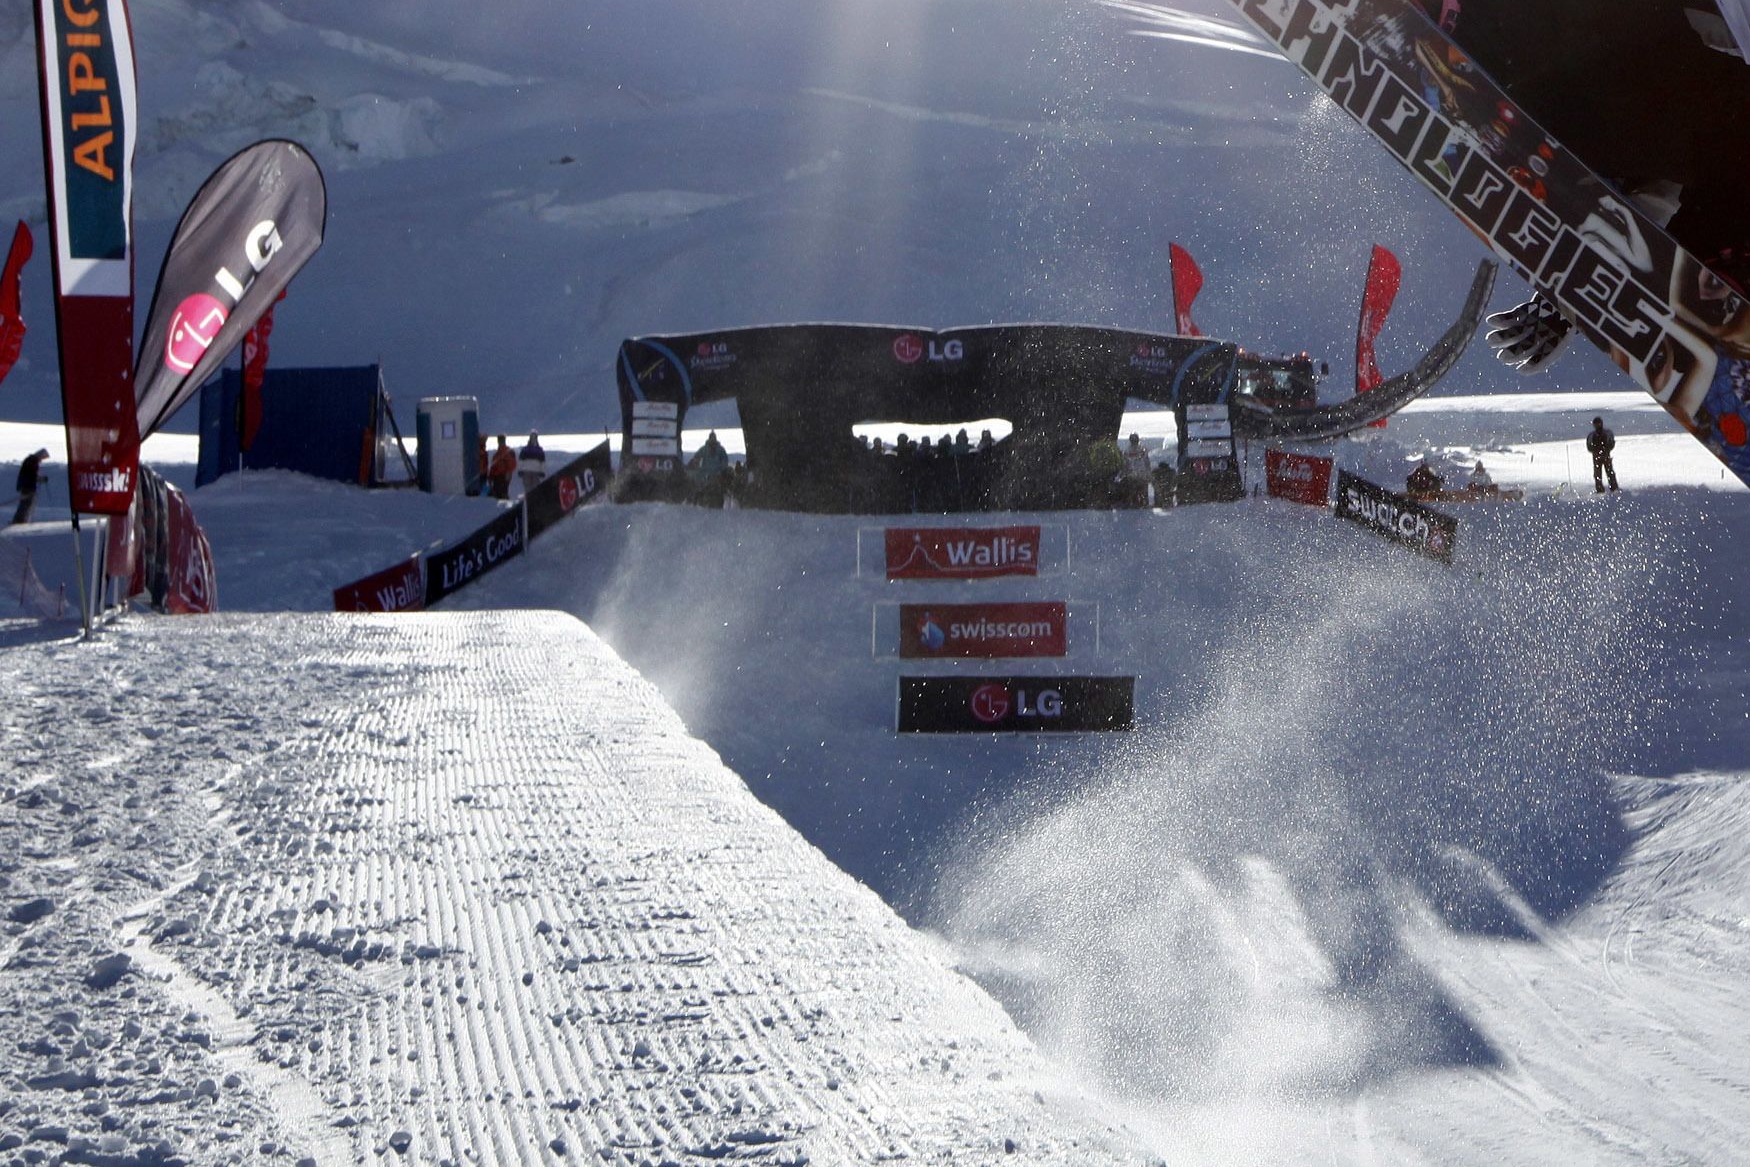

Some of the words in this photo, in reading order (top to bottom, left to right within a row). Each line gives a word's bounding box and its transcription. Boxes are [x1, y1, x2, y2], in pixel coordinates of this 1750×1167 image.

[215, 220, 284, 302] LG
[929, 341, 964, 361] LG
[576, 468, 595, 498] LG
[1347, 487, 1430, 547] swatch
[443, 548, 483, 589] Life's
[486, 516, 520, 563] Good
[946, 537, 1032, 566] Wallis
[950, 617, 1052, 640] swisscom
[1017, 690, 1061, 717] LG
